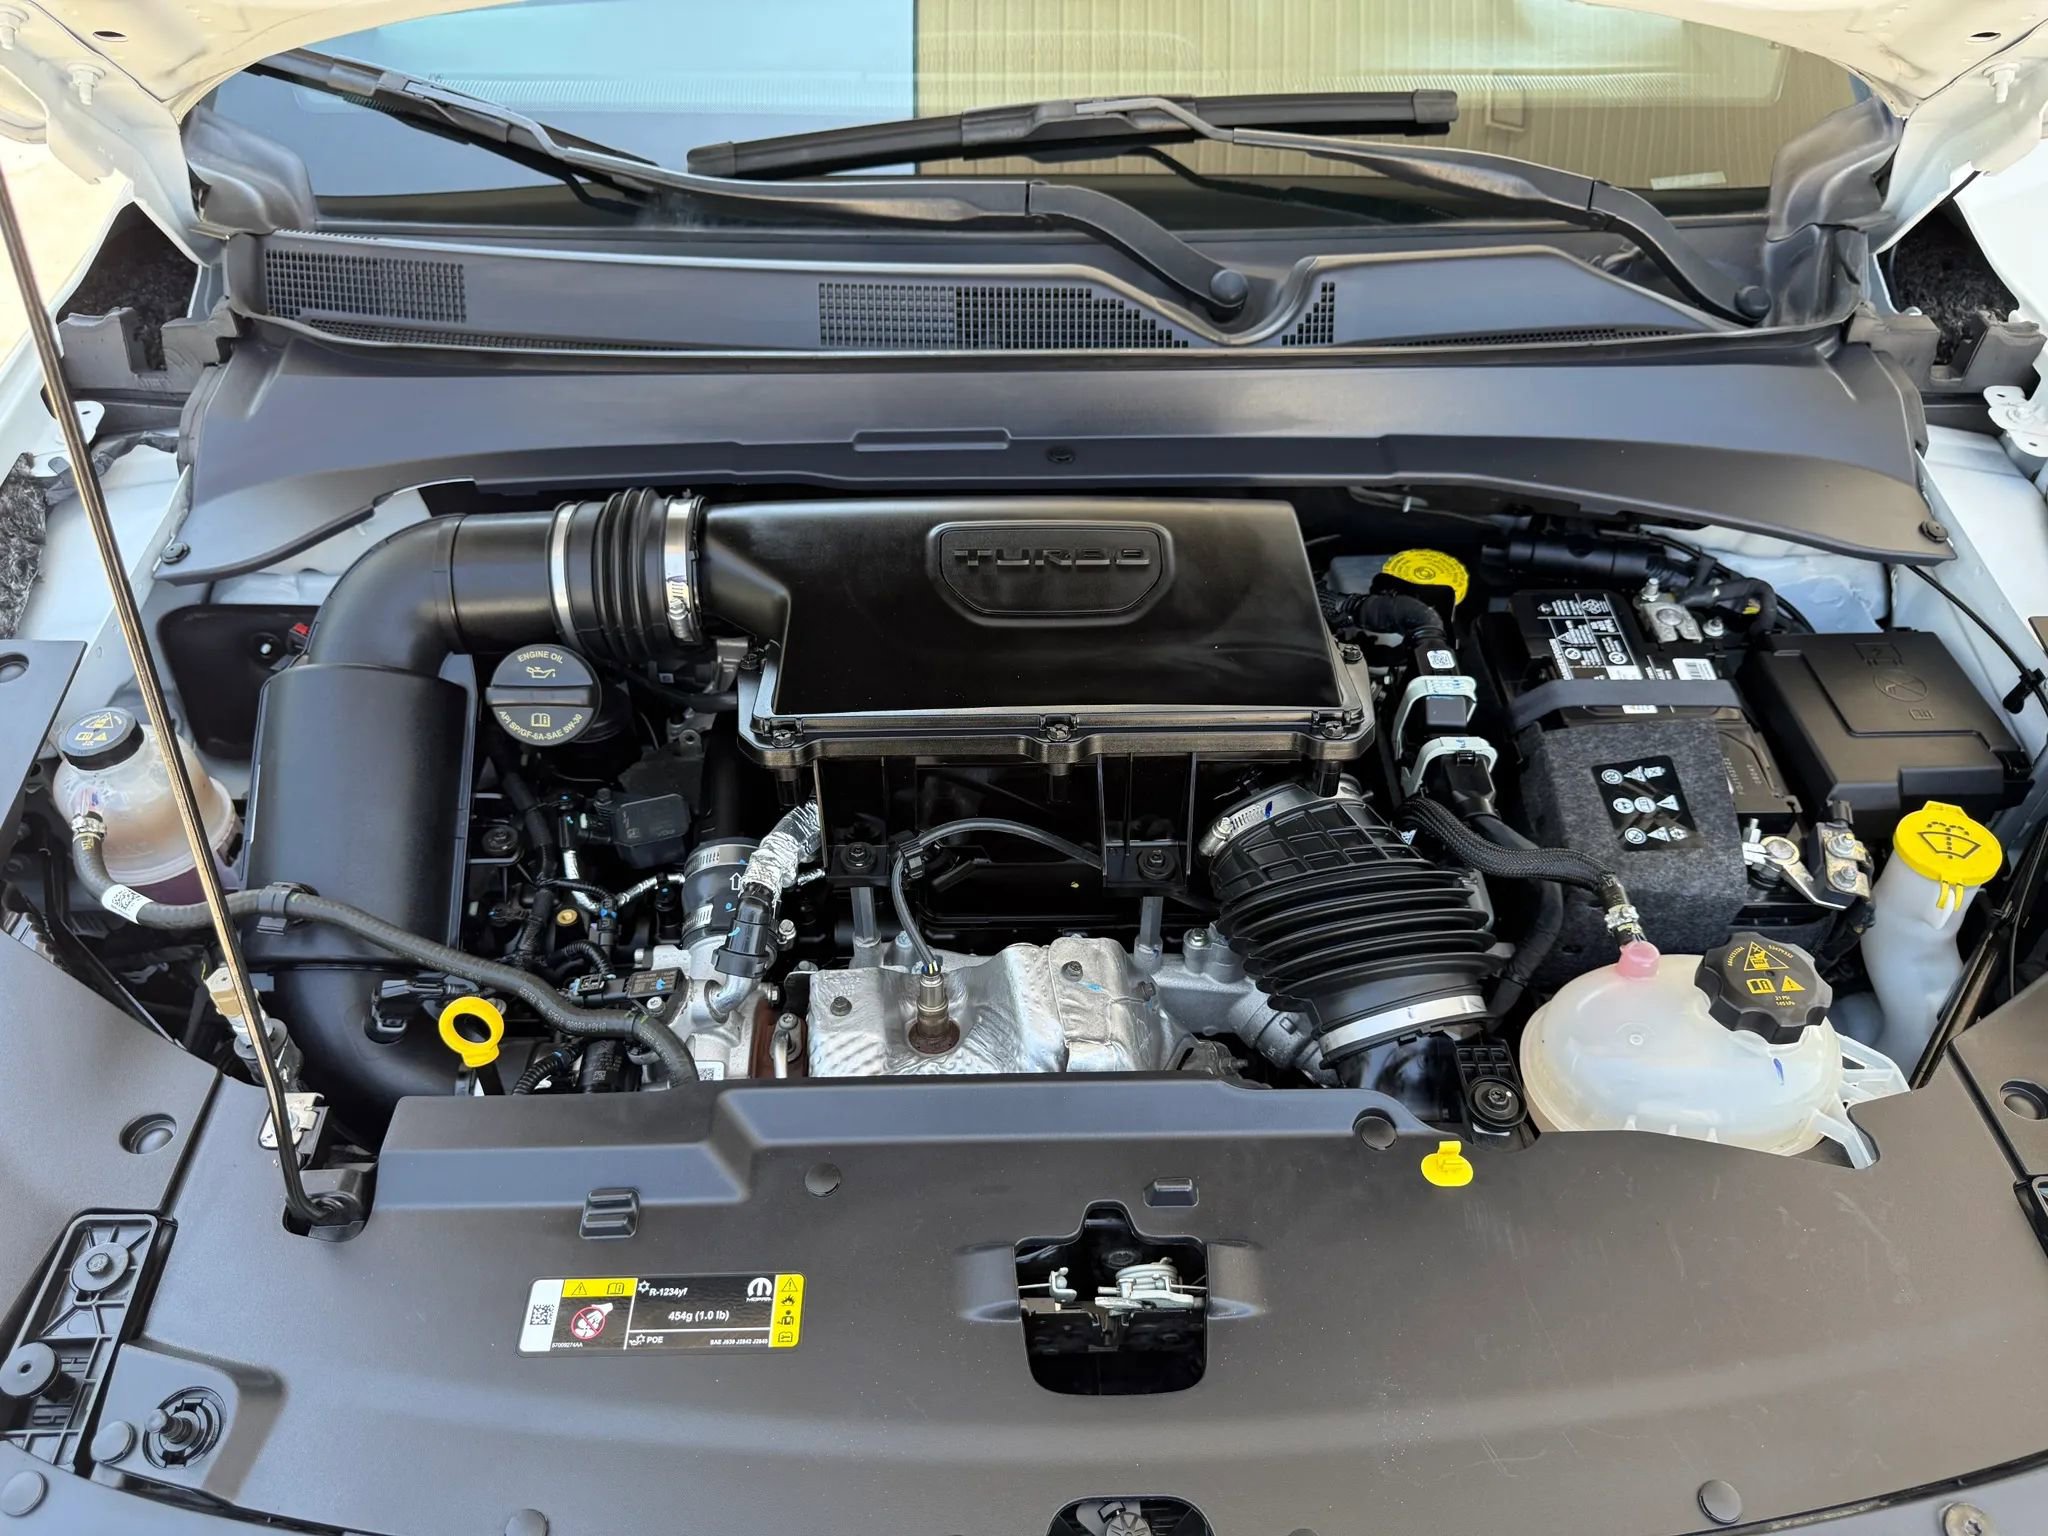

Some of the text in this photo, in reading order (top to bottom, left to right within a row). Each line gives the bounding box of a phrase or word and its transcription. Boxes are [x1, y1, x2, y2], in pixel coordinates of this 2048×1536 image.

[953, 548, 1150, 566] TURBO
[518, 651, 563, 664] ENGINE OIL
[499, 711, 511, 724] API
[564, 714, 583, 733] 5W-30
[648, 1286, 688, 1298] R-1234yf
[668, 1309, 730, 1323] 454g (1.0 lb)
[646, 1335, 664, 1344] POE
